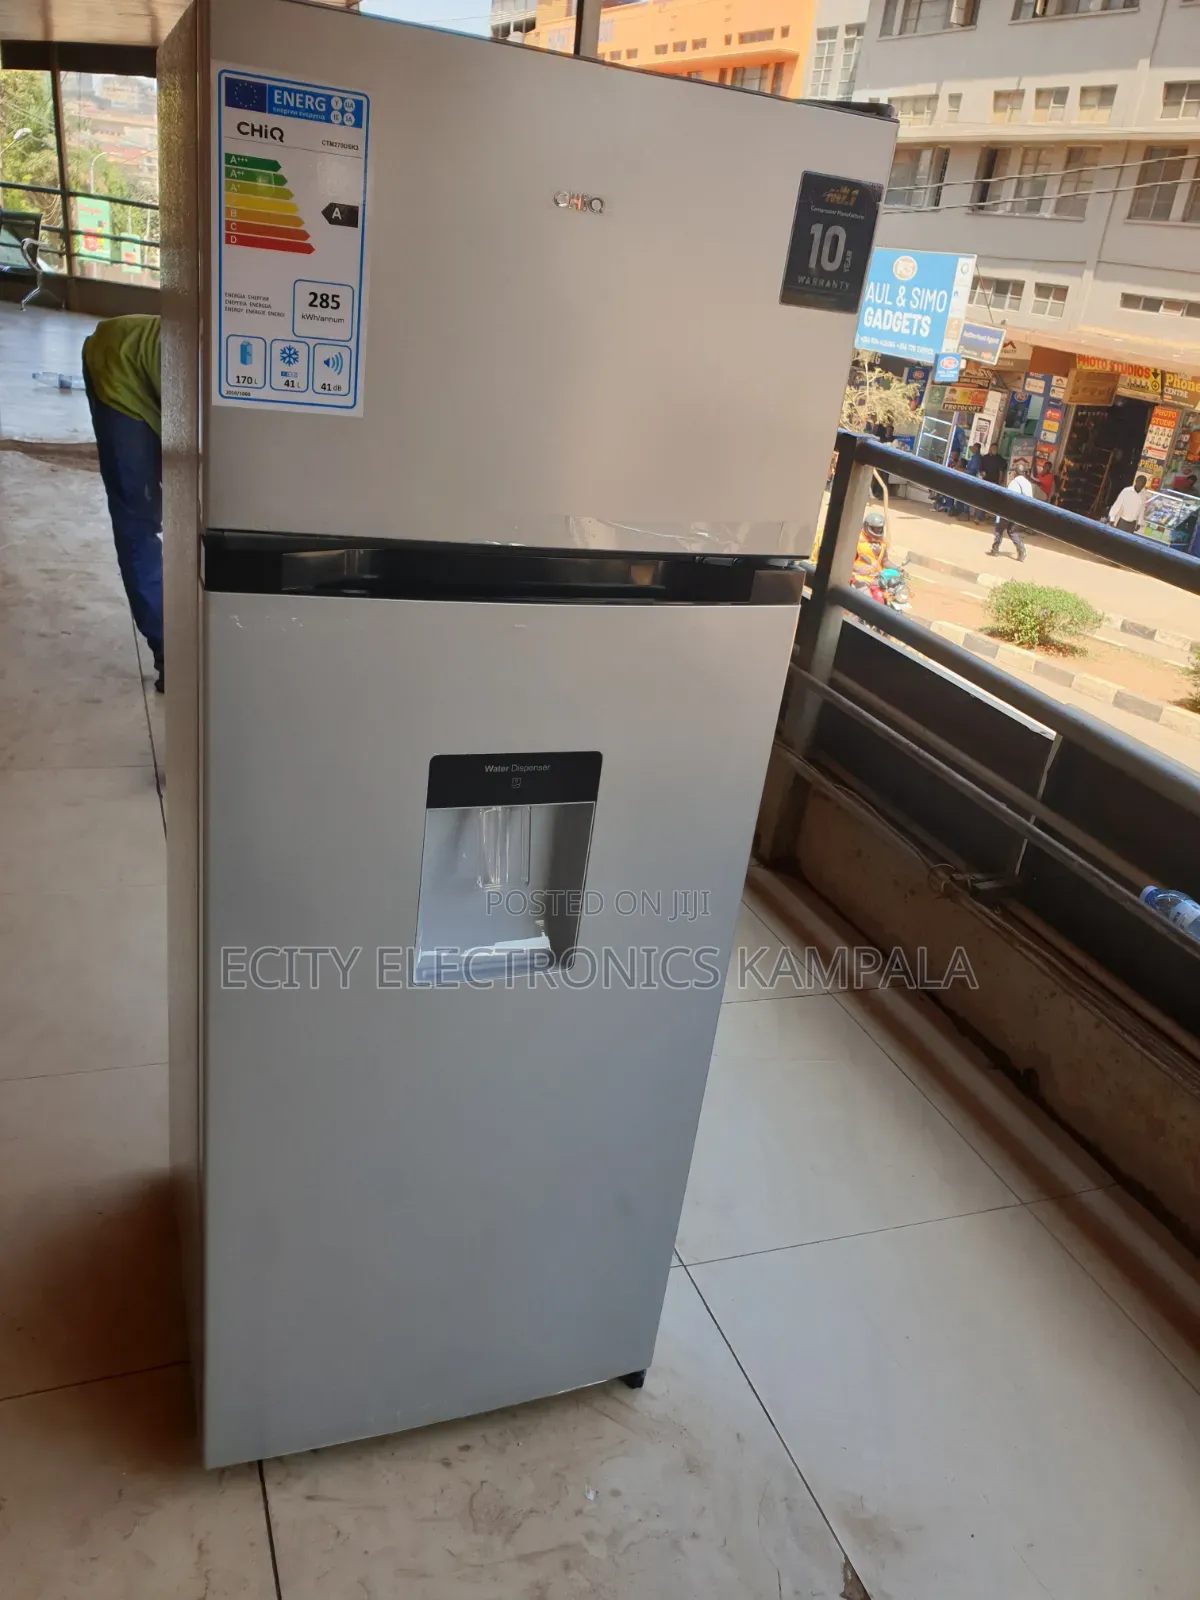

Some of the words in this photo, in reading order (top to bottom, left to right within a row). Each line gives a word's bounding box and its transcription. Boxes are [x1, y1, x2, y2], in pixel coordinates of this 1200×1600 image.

[273, 89, 327, 112] ENERG
[236, 121, 285, 143] CHiQ
[230, 155, 248, 165] A+++
[230, 169, 245, 178] A++
[230, 209, 237, 217] B
[331, 207, 342, 220] A
[230, 222, 237, 231] C
[230, 235, 238, 244] D
[808, 222, 847, 272] 10
[797, 275, 851, 291] WARRANTY
[308, 291, 341, 310] 285
[863, 281, 893, 306] AUL
[895, 285, 907, 307] &
[909, 286, 949, 314] SIMO
[301, 313, 345, 324] kWh/annum
[863, 306, 932, 338] GADGETS
[1077, 353, 1108, 370] PHOTO
[1109, 360, 1152, 380] STUDIOS
[235, 375, 253, 385] 170
[284, 379, 295, 388] 41
[1165, 372, 1200, 393] Phone
[320, 382, 332, 392] 41
[333, 383, 342, 392] dB
[1163, 386, 1189, 399] CENTRE
[1154, 407, 1177, 418] PHOTO
[1150, 416, 1176, 429] STUDIO
[484, 764, 510, 773] Water
[511, 764, 551, 773] Dispenser
